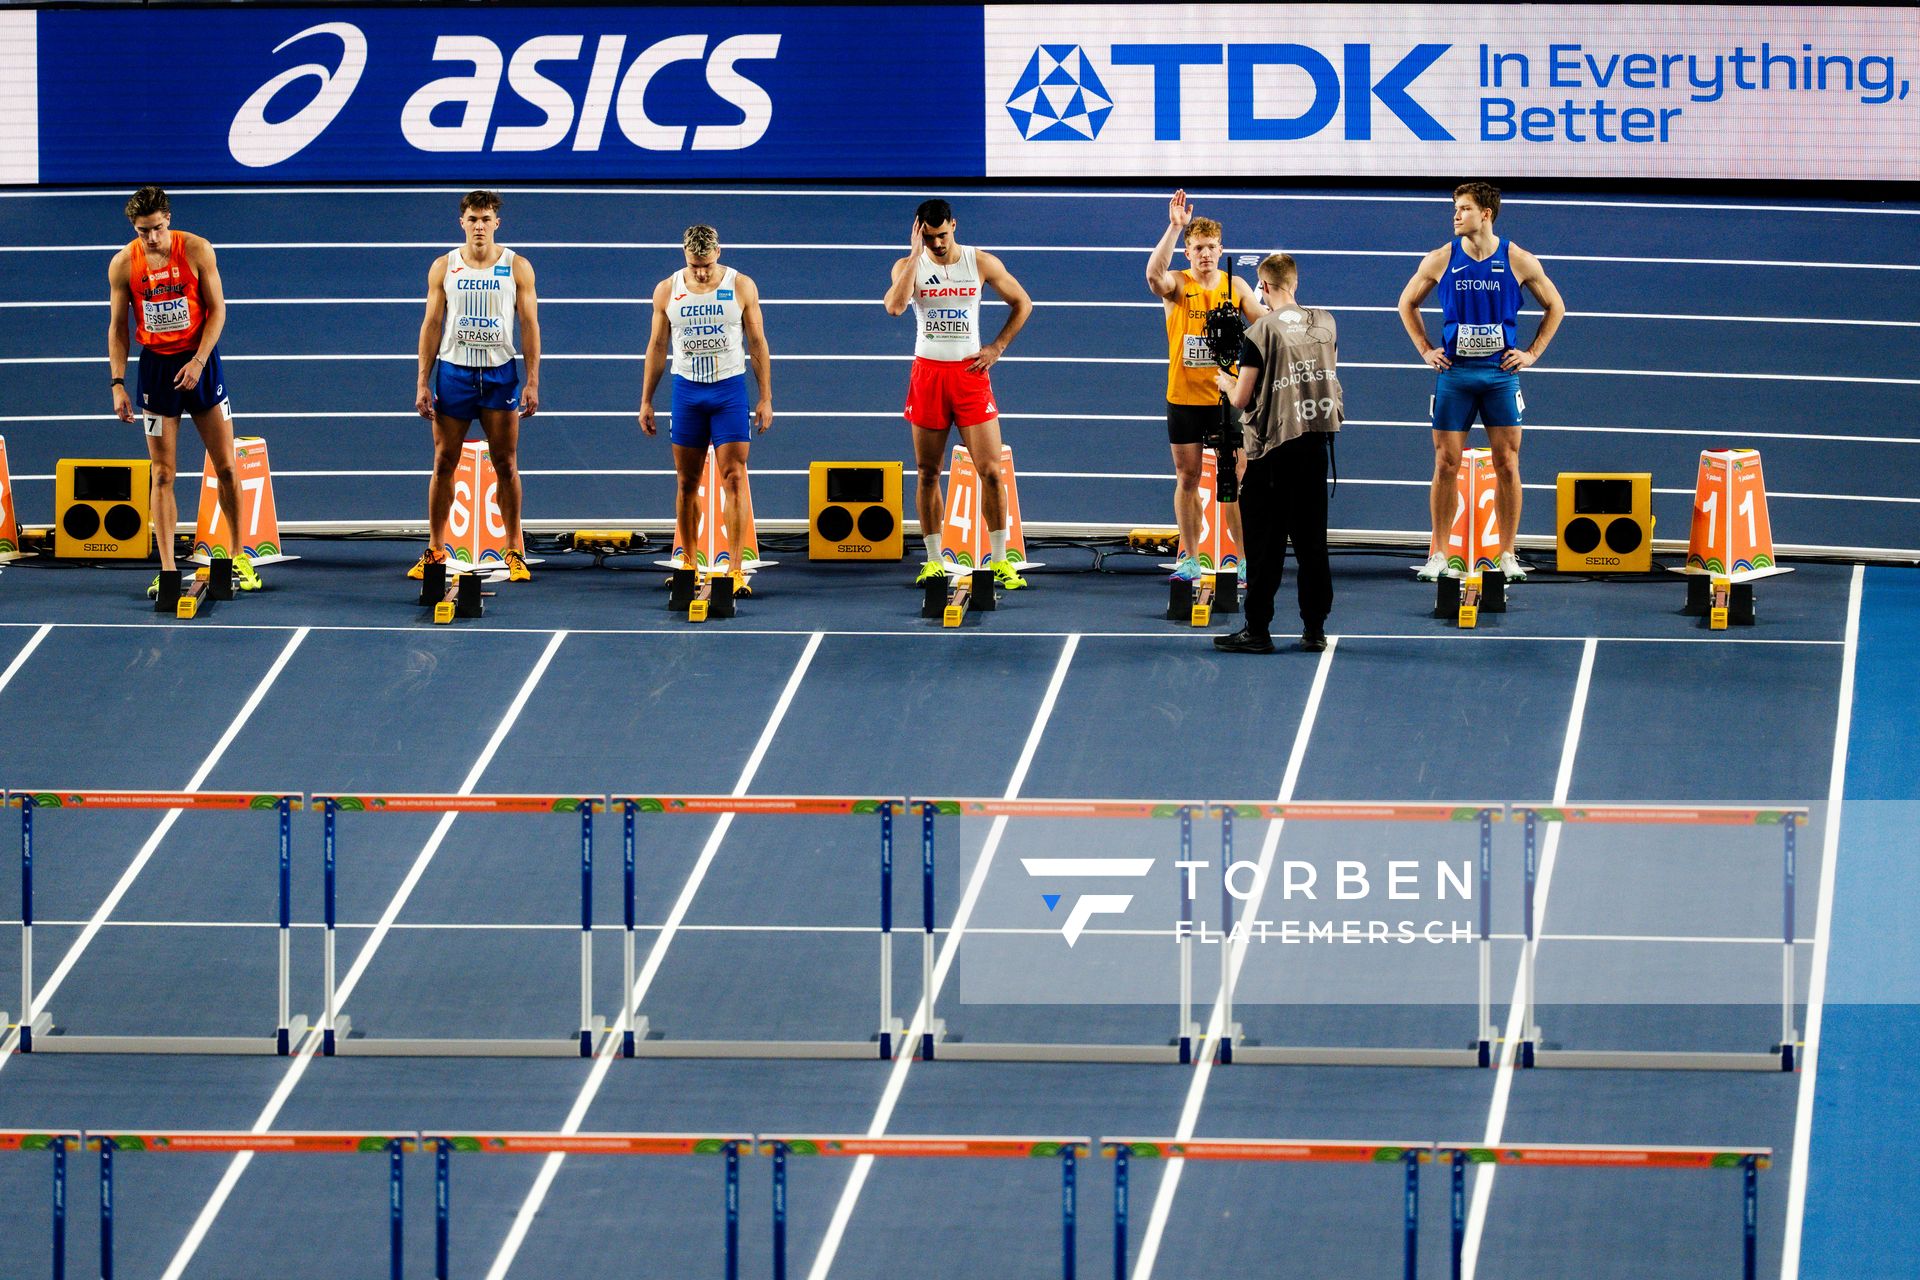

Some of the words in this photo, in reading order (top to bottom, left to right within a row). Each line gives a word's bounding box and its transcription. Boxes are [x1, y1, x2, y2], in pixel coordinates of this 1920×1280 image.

[1479, 44, 1529, 88] In
[1549, 43, 1910, 104] Everything,
[1110, 43, 1456, 141] TDK
[1479, 97, 1682, 142] Better
[457, 279, 500, 290] CZECHIA
[1455, 279, 1501, 291] ESTONIA
[920, 287, 977, 298] FRANCE
[153, 298, 184, 312] TDK
[680, 304, 724, 317] CZECHIA
[145, 310, 188, 325] TESSELAAR
[936, 309, 968, 319] TDK
[469, 317, 500, 328] TDK
[925, 320, 970, 332] BASTIEN
[692, 324, 725, 335] TDK
[1469, 324, 1499, 336] TDK
[1458, 336, 1502, 349] ROOSLEHT
[1288, 359, 1316, 373] HOST
[147, 417, 157, 433] 7
[240, 475, 265, 537] 7
[449, 480, 472, 538] 6
[949, 484, 972, 543] 4
[1478, 487, 1501, 547] 2
[1702, 491, 1718, 549] 1
[1738, 489, 1757, 548] 1
[83, 543, 119, 552] SEIKO
[837, 544, 872, 553] SEIKO
[1585, 556, 1621, 566] SEIKO
